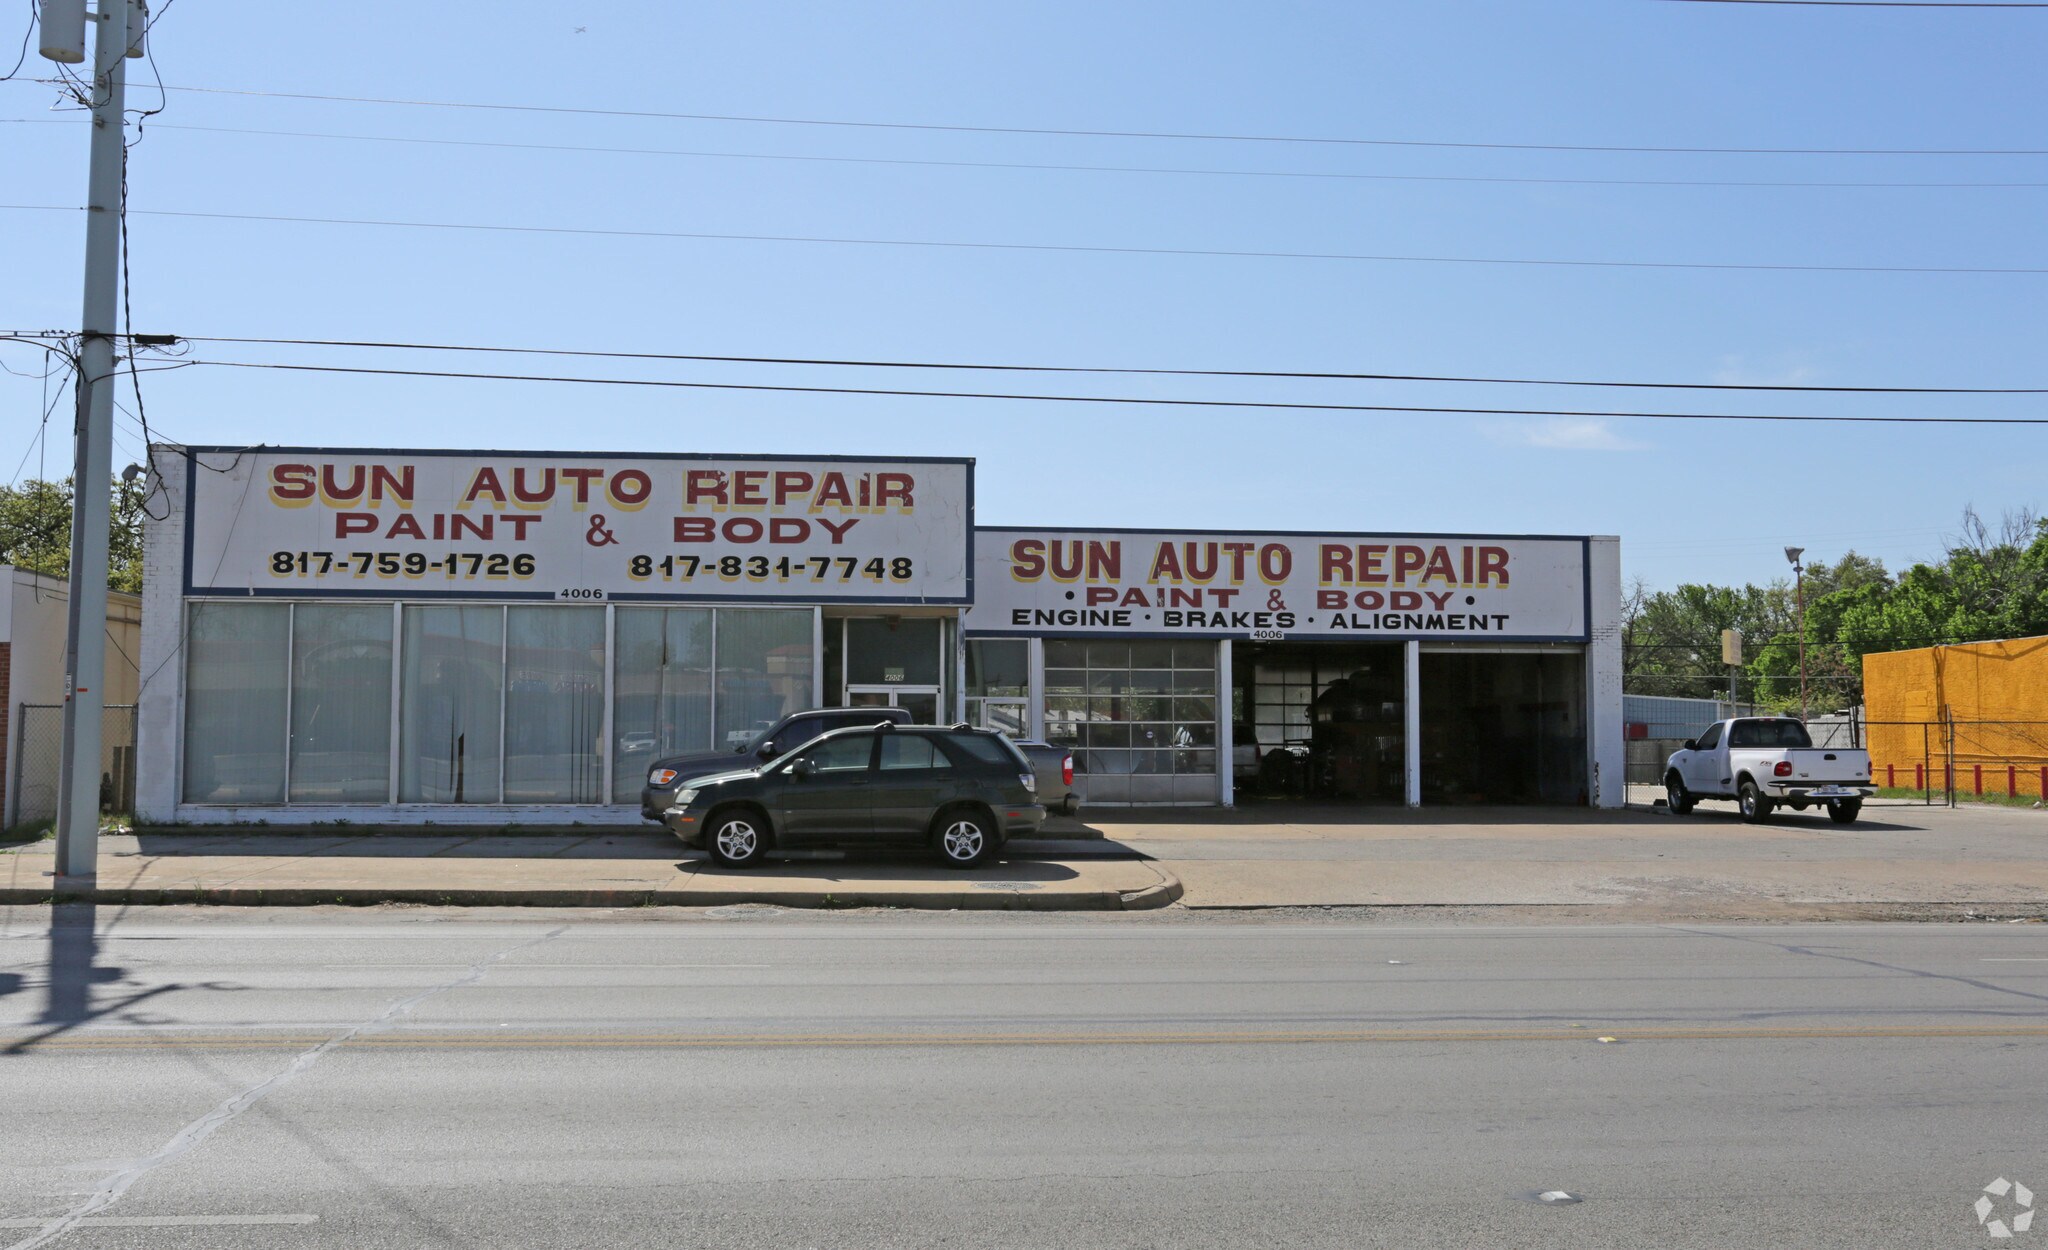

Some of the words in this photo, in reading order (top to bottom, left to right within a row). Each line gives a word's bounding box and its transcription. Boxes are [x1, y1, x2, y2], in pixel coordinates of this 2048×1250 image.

[269, 464, 415, 509] SUN
[457, 467, 652, 512] AUTO
[682, 470, 914, 515] REPAIR
[335, 512, 542, 541] PAINT
[586, 513, 620, 547] &
[673, 516, 860, 545] BODY
[269, 551, 536, 580] 817-759-1726
[628, 554, 914, 583] 817-831-7748
[1010, 539, 1121, 584] SUN
[1147, 541, 1292, 586] AUTO
[1319, 544, 1510, 589] REPAIR
[560, 588, 603, 600] 4006
[1086, 587, 1240, 608] PAINT
[1266, 588, 1287, 612] &
[1316, 589, 1455, 611] BODY
[1011, 608, 1132, 627] ENGINE
[1163, 610, 1296, 629] BRAKES
[1329, 612, 1510, 631] ALIGNMENT
[1253, 630, 1283, 640] 4006
